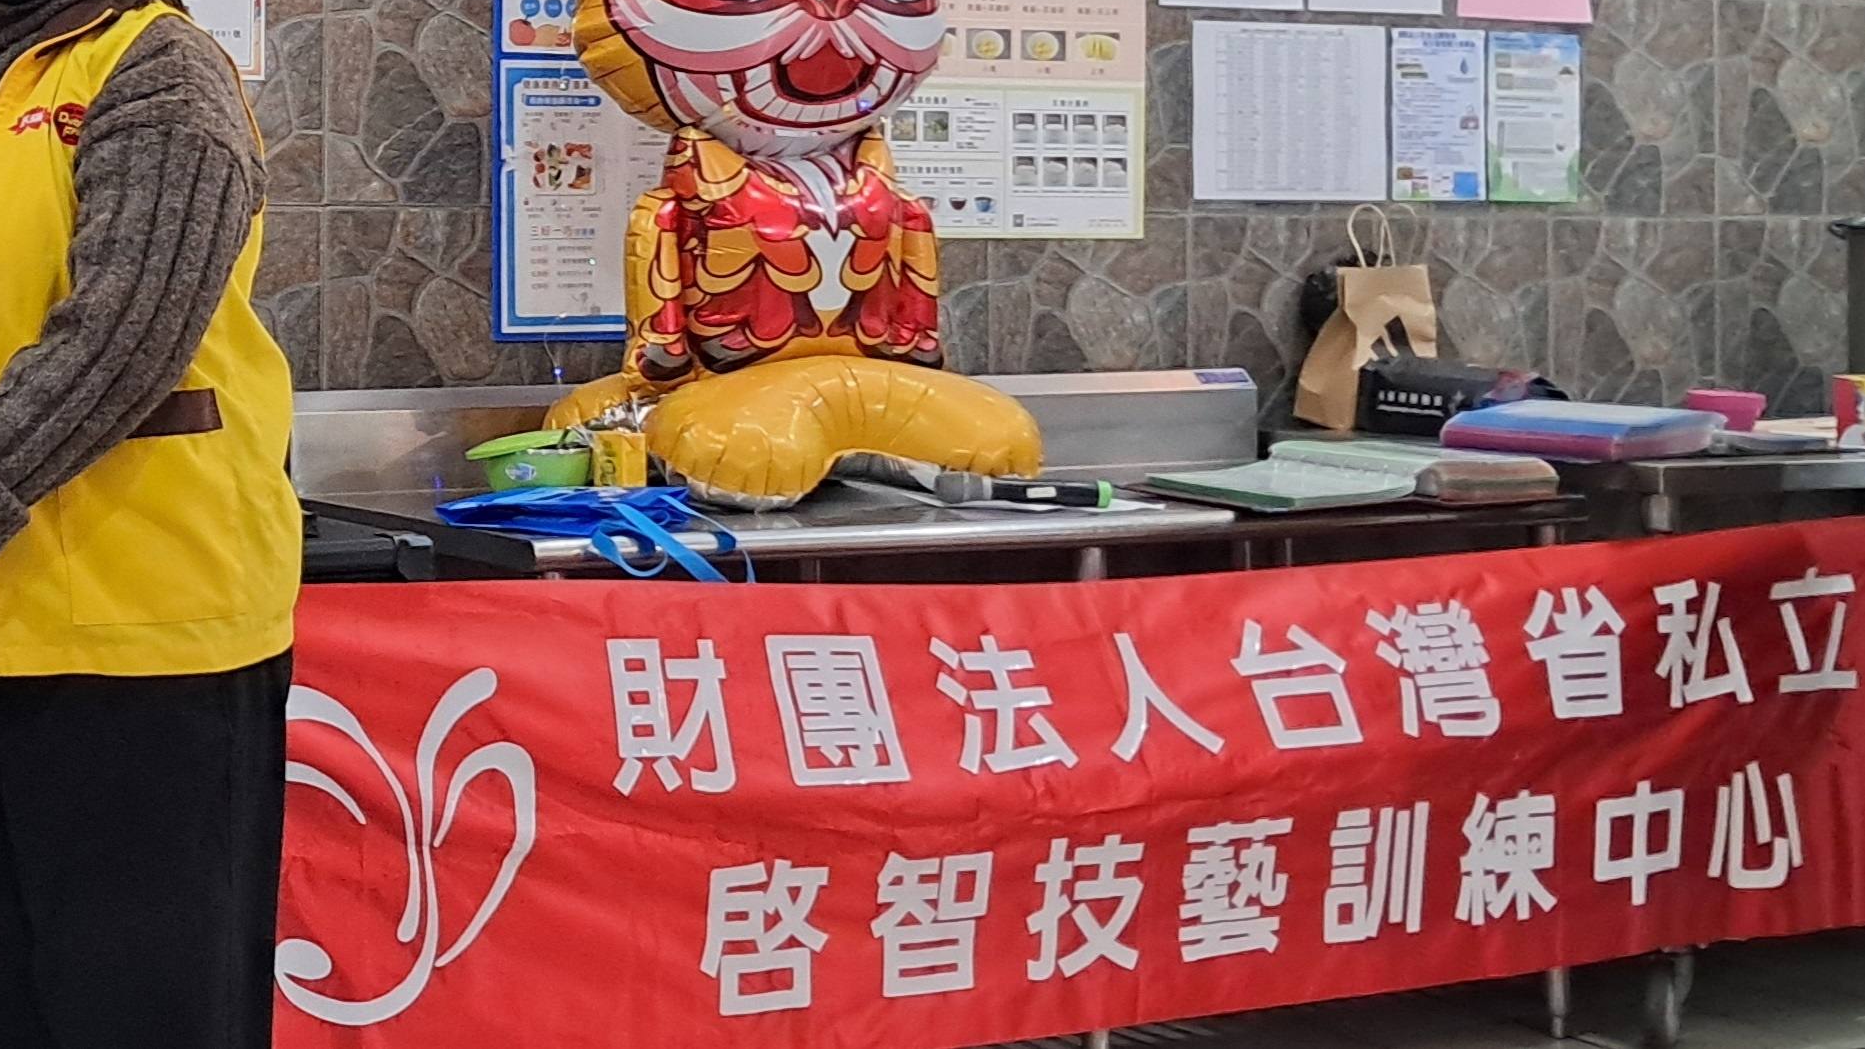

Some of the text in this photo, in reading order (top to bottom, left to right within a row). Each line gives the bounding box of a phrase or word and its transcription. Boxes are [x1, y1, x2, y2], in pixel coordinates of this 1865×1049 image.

[606, 567, 1858, 796] 財團法人台灣省私立
